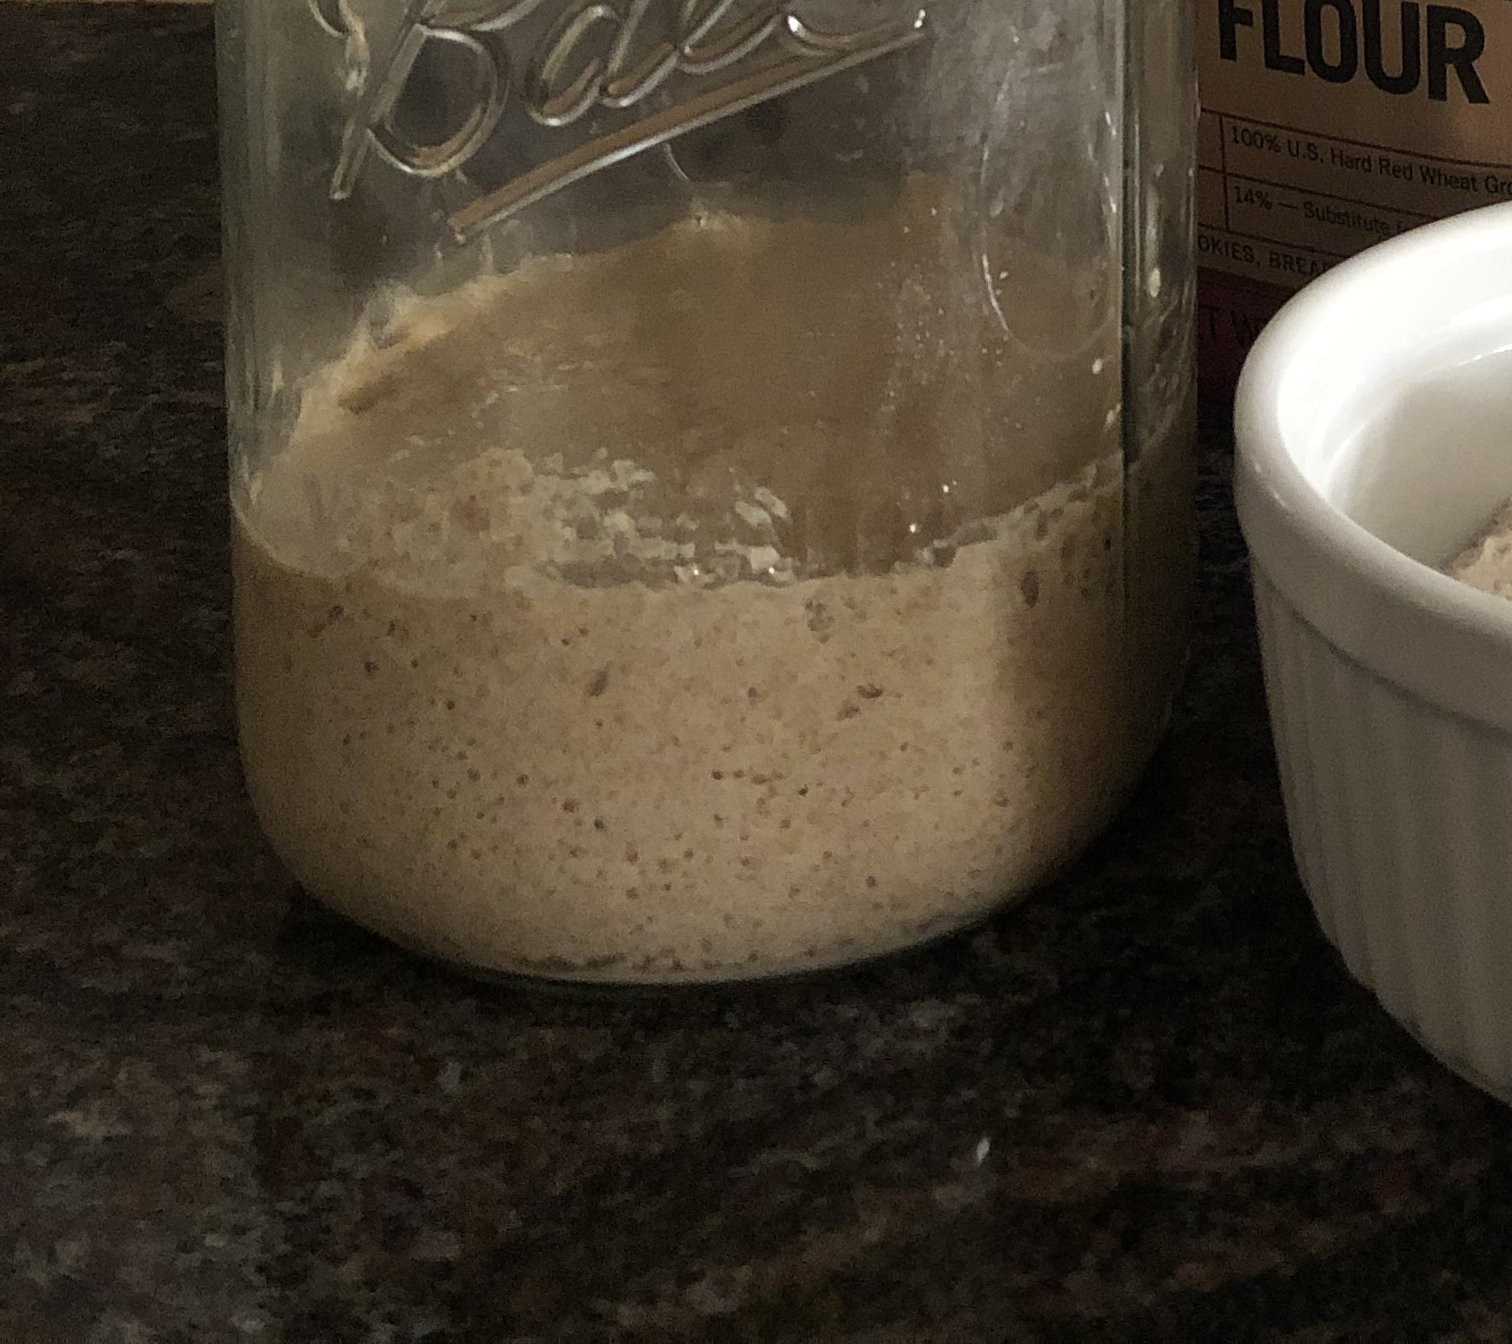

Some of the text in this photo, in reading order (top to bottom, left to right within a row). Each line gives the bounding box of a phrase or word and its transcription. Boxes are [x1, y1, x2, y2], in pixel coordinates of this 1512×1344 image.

[1230, 124, 1282, 155] 100%
[1330, 147, 1373, 175] Hard
[1378, 157, 1415, 182] Red
[1418, 163, 1479, 194] Wheat
[1233, 185, 1391, 237] 14% Substitute
[1198, 233, 1262, 268] OKIES,
